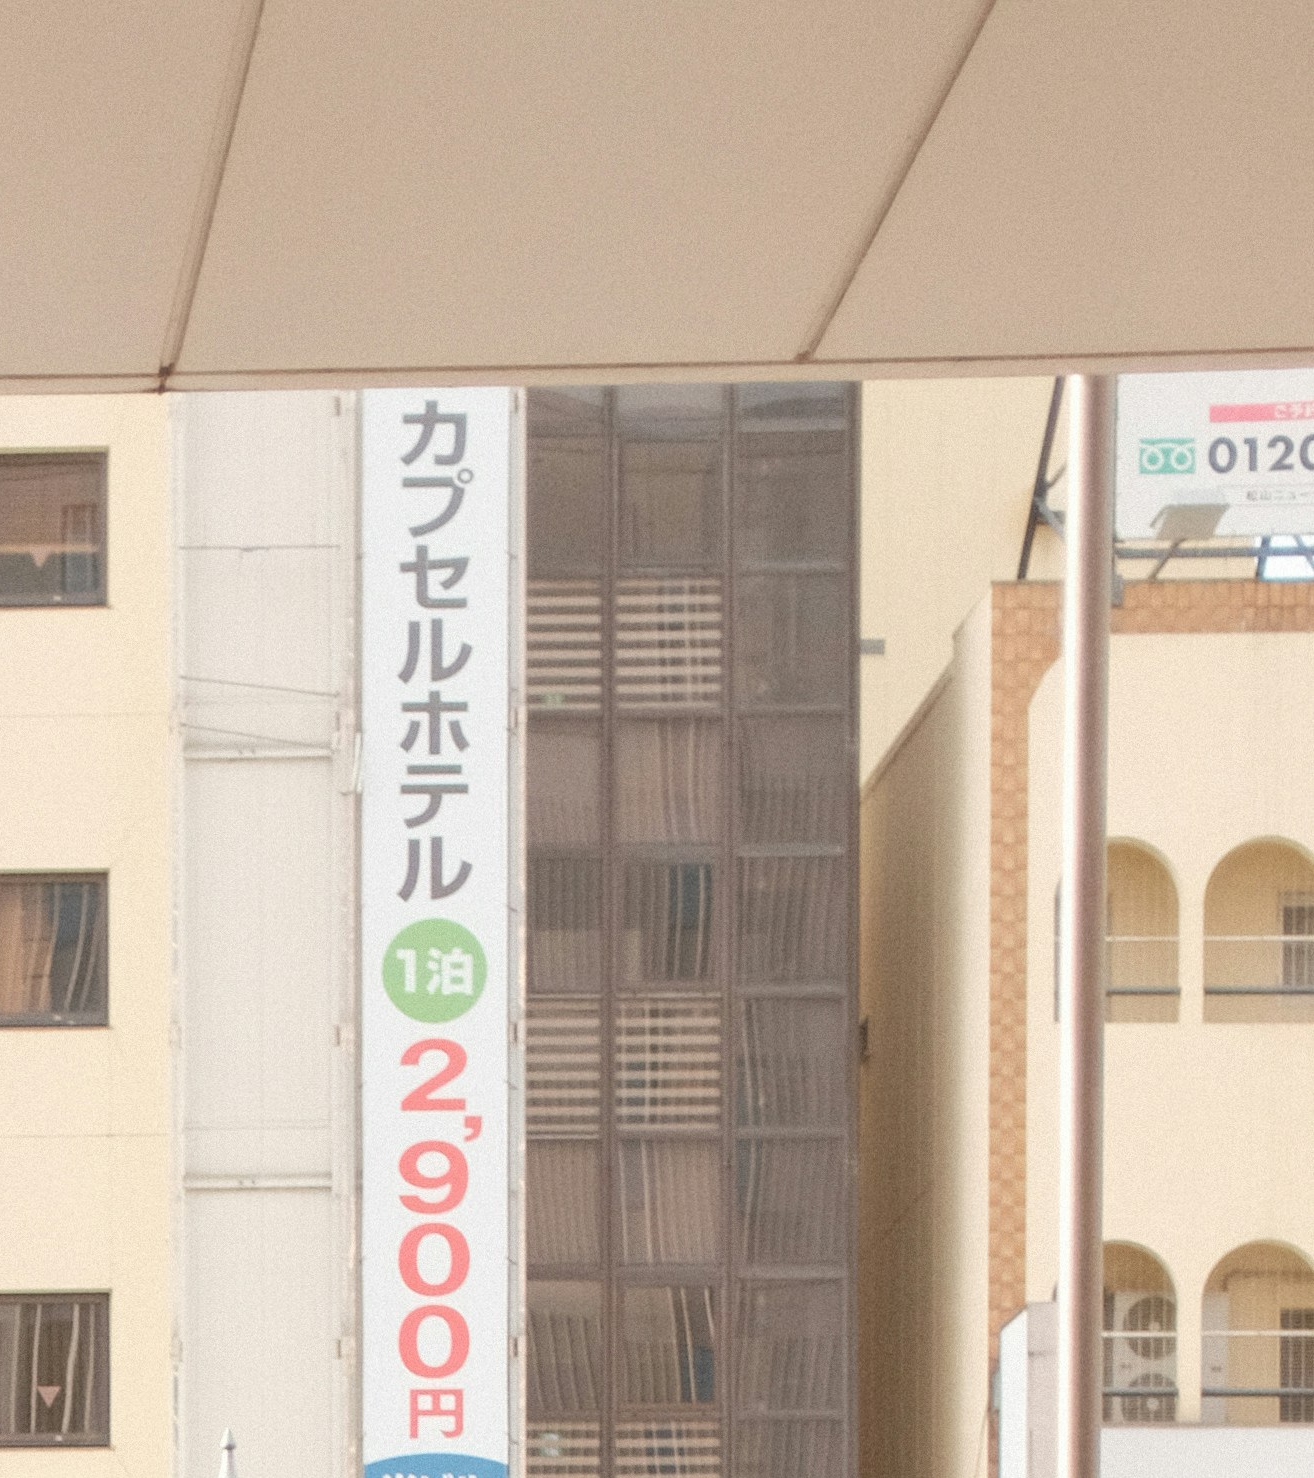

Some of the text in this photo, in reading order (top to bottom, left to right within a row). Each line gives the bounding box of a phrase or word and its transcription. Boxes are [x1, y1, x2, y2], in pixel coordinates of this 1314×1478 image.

[397, 400, 474, 902] カプセルホテル
[396, 947, 474, 998] 1泊
